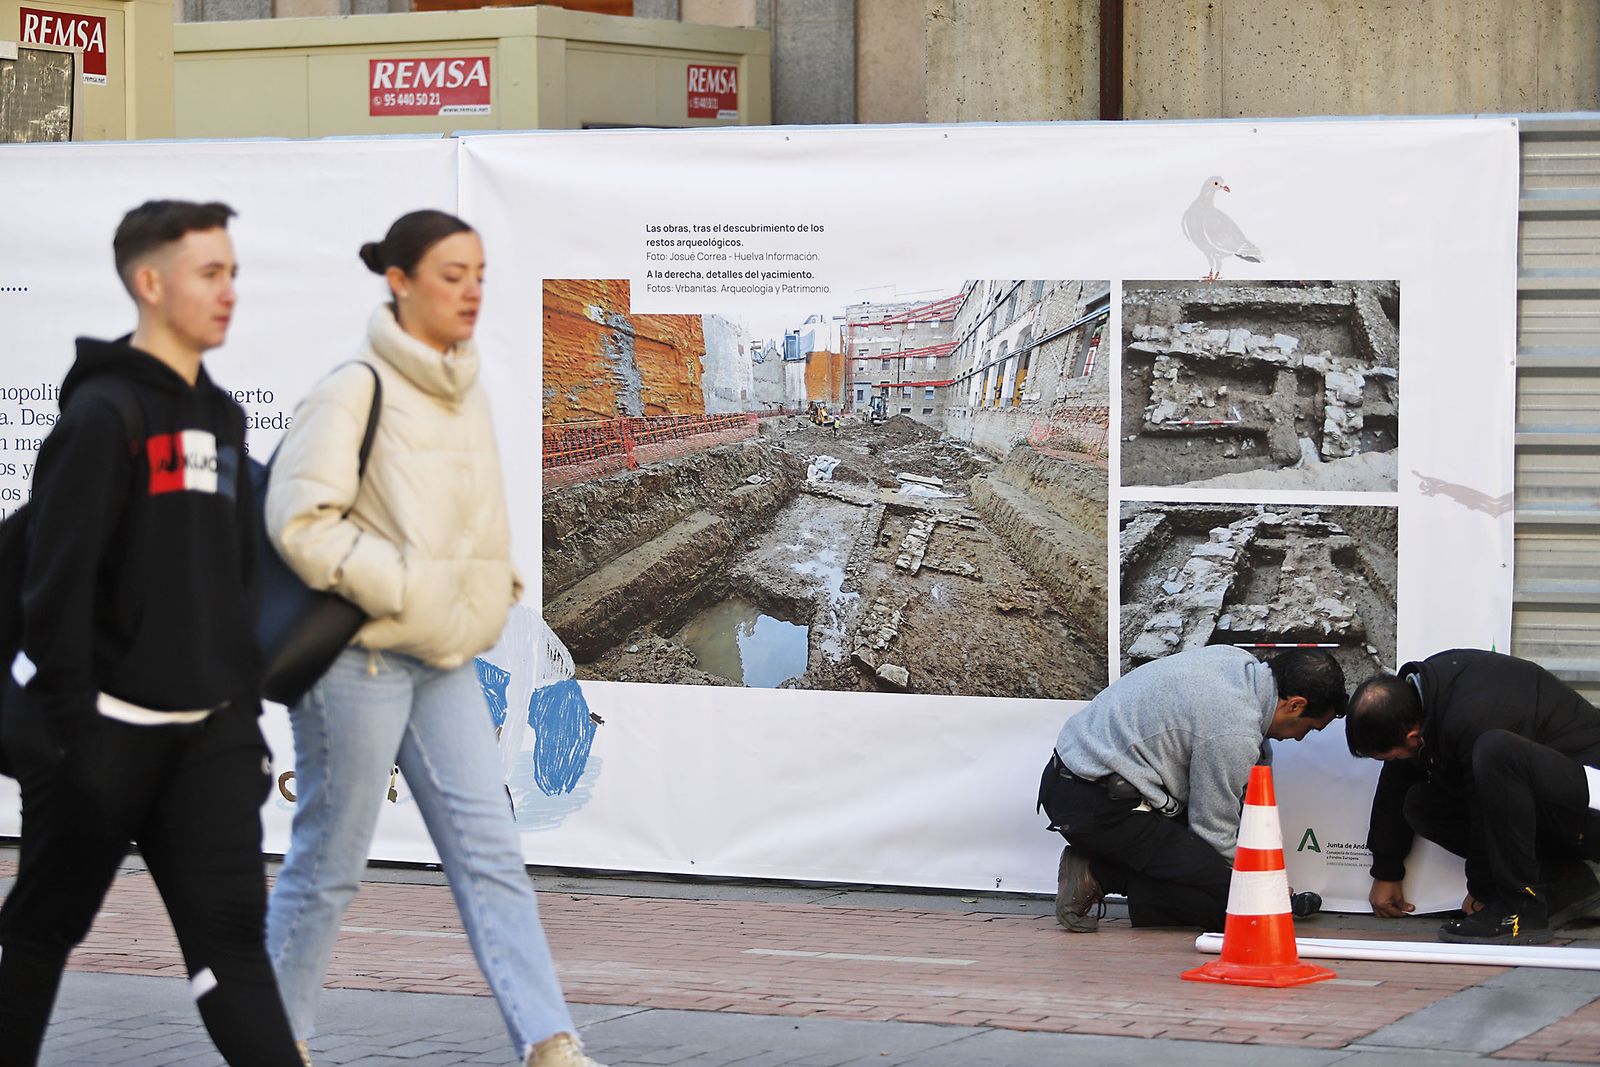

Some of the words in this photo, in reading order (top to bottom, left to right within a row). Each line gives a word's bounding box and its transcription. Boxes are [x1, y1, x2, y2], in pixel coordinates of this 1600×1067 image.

[23, 13, 104, 53] REMSA
[372, 60, 488, 89] REMSA
[689, 68, 737, 94] REMSA
[384, 93, 396, 107] 95
[397, 93, 415, 106] 440
[416, 93, 428, 106] 50
[429, 92, 441, 105] 21
[646, 223, 662, 233] Las
[663, 223, 691, 234] obras,
[693, 224, 712, 233] tras
[713, 223, 721, 233] el
[723, 223, 796, 233] descubrimiento
[797, 223, 809, 233] de
[810, 223, 825, 233] los
[646, 238, 675, 247] restos
[676, 237, 744, 249] arqueológicos.
[646, 252, 668, 261] Foto:
[669, 251, 696, 261] Josué
[697, 252, 727, 261] Correa
[734, 252, 764, 261] Huelva
[765, 251, 821, 261] Información.
[646, 270, 654, 279] A
[654, 270, 663, 279] la
[664, 270, 704, 280] derecha,
[706, 270, 743, 279] detalles
[744, 270, 759, 279] del
[760, 270, 815, 281] yacimiento.
[646, 284, 674, 293] Fotos:
[675, 284, 719, 293] Vrbanitas.
[720, 284, 774, 295] Arqueología
[775, 286, 781, 295] y
[781, 284, 832, 294] Patrimonio.
[22, 463, 34, 481] y
